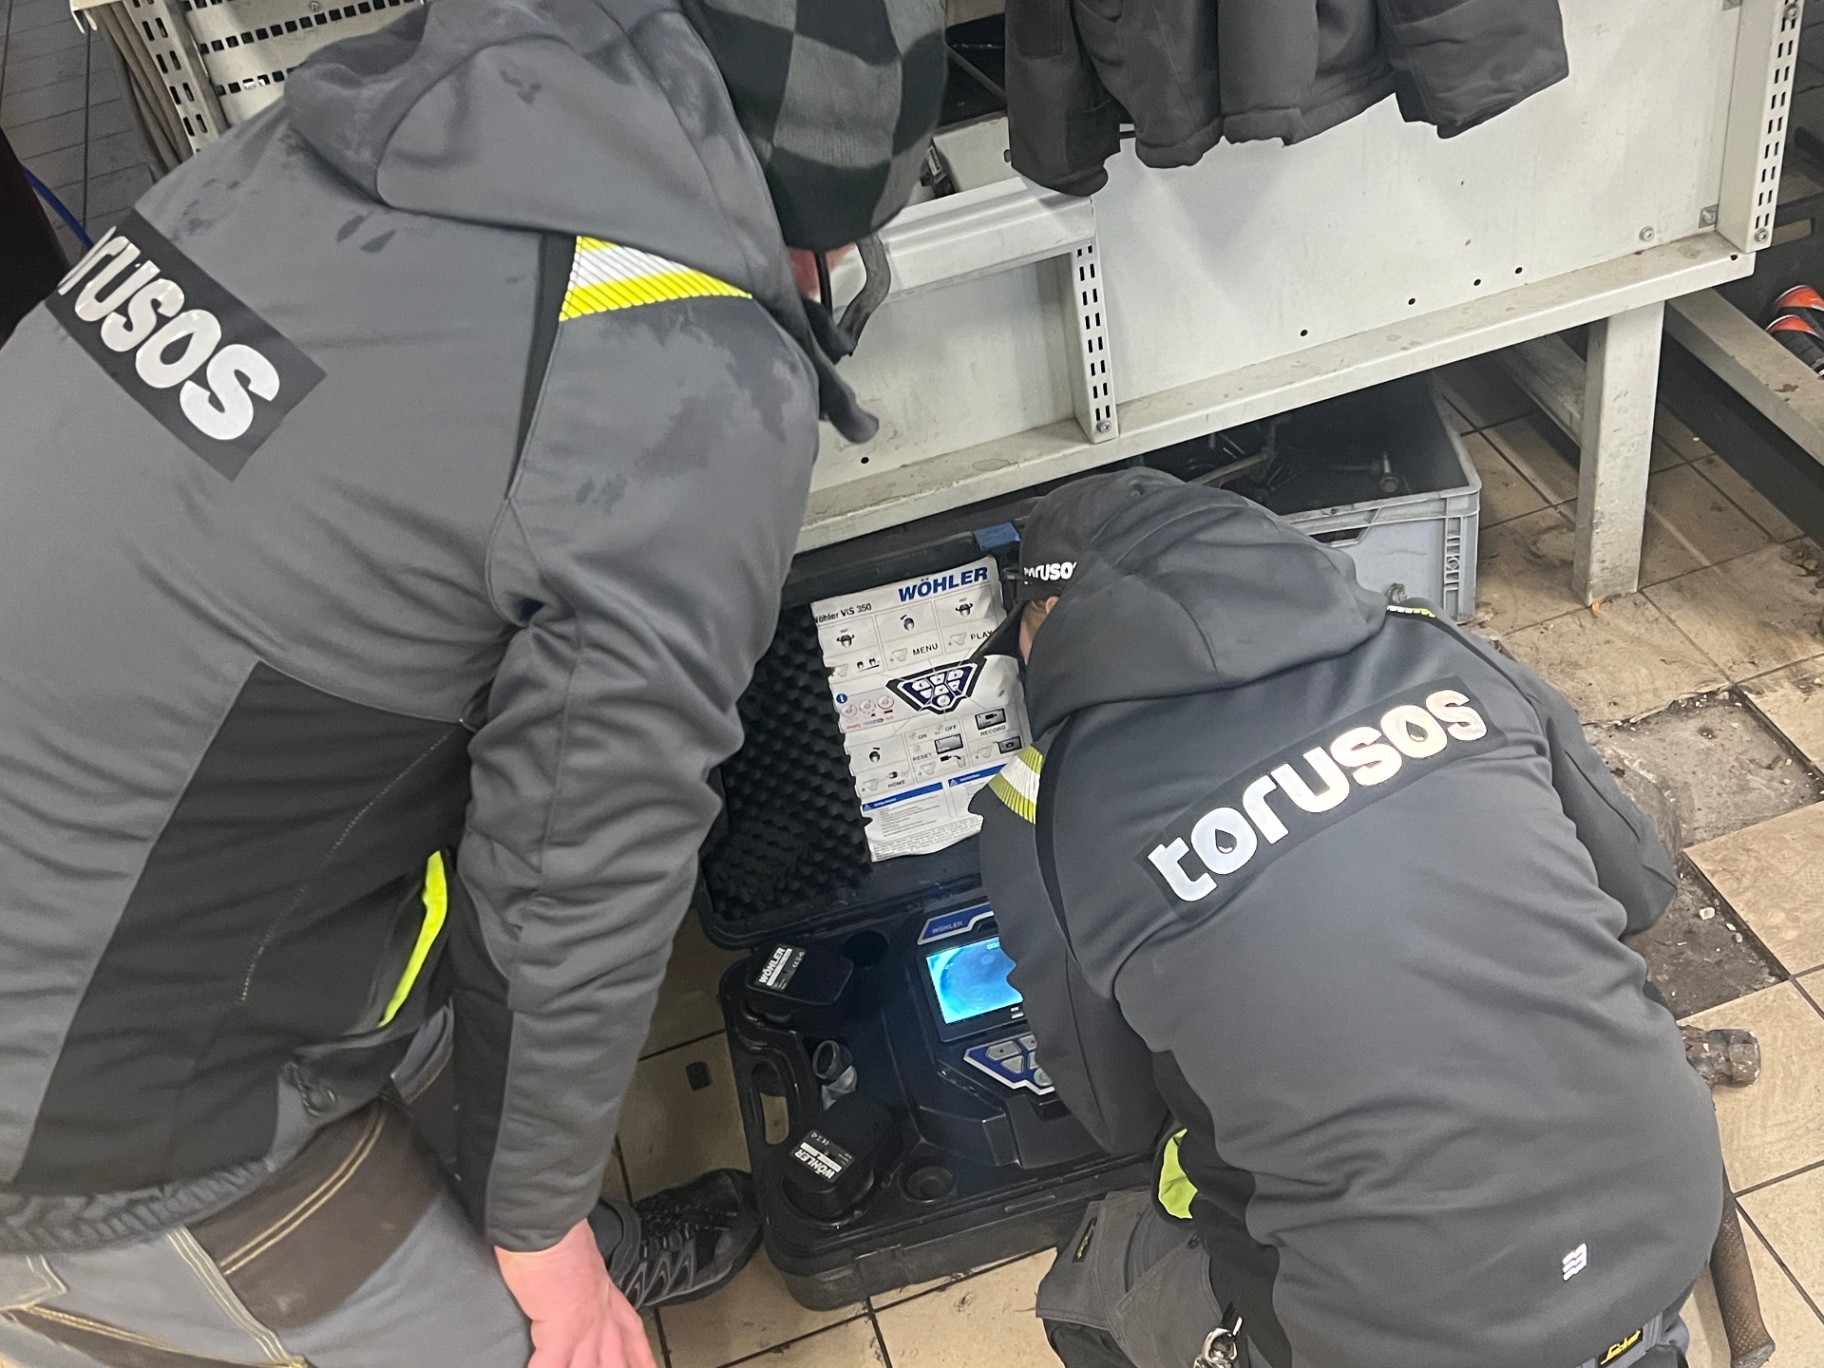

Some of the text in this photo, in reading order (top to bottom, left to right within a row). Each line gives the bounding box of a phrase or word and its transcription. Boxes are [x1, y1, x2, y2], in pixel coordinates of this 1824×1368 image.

[898, 567, 988, 602] WÖHLER
[840, 607, 855, 617] VIS
[857, 603, 872, 613] 350
[912, 643, 939, 656] MENU
[944, 724, 957, 732] OFF
[980, 725, 1006, 737] RECORD
[912, 753, 932, 762] RESET
[1148, 690, 1487, 901] torusos
[758, 947, 785, 984] WÖHLER
[794, 1149, 835, 1179] WÖHLER
